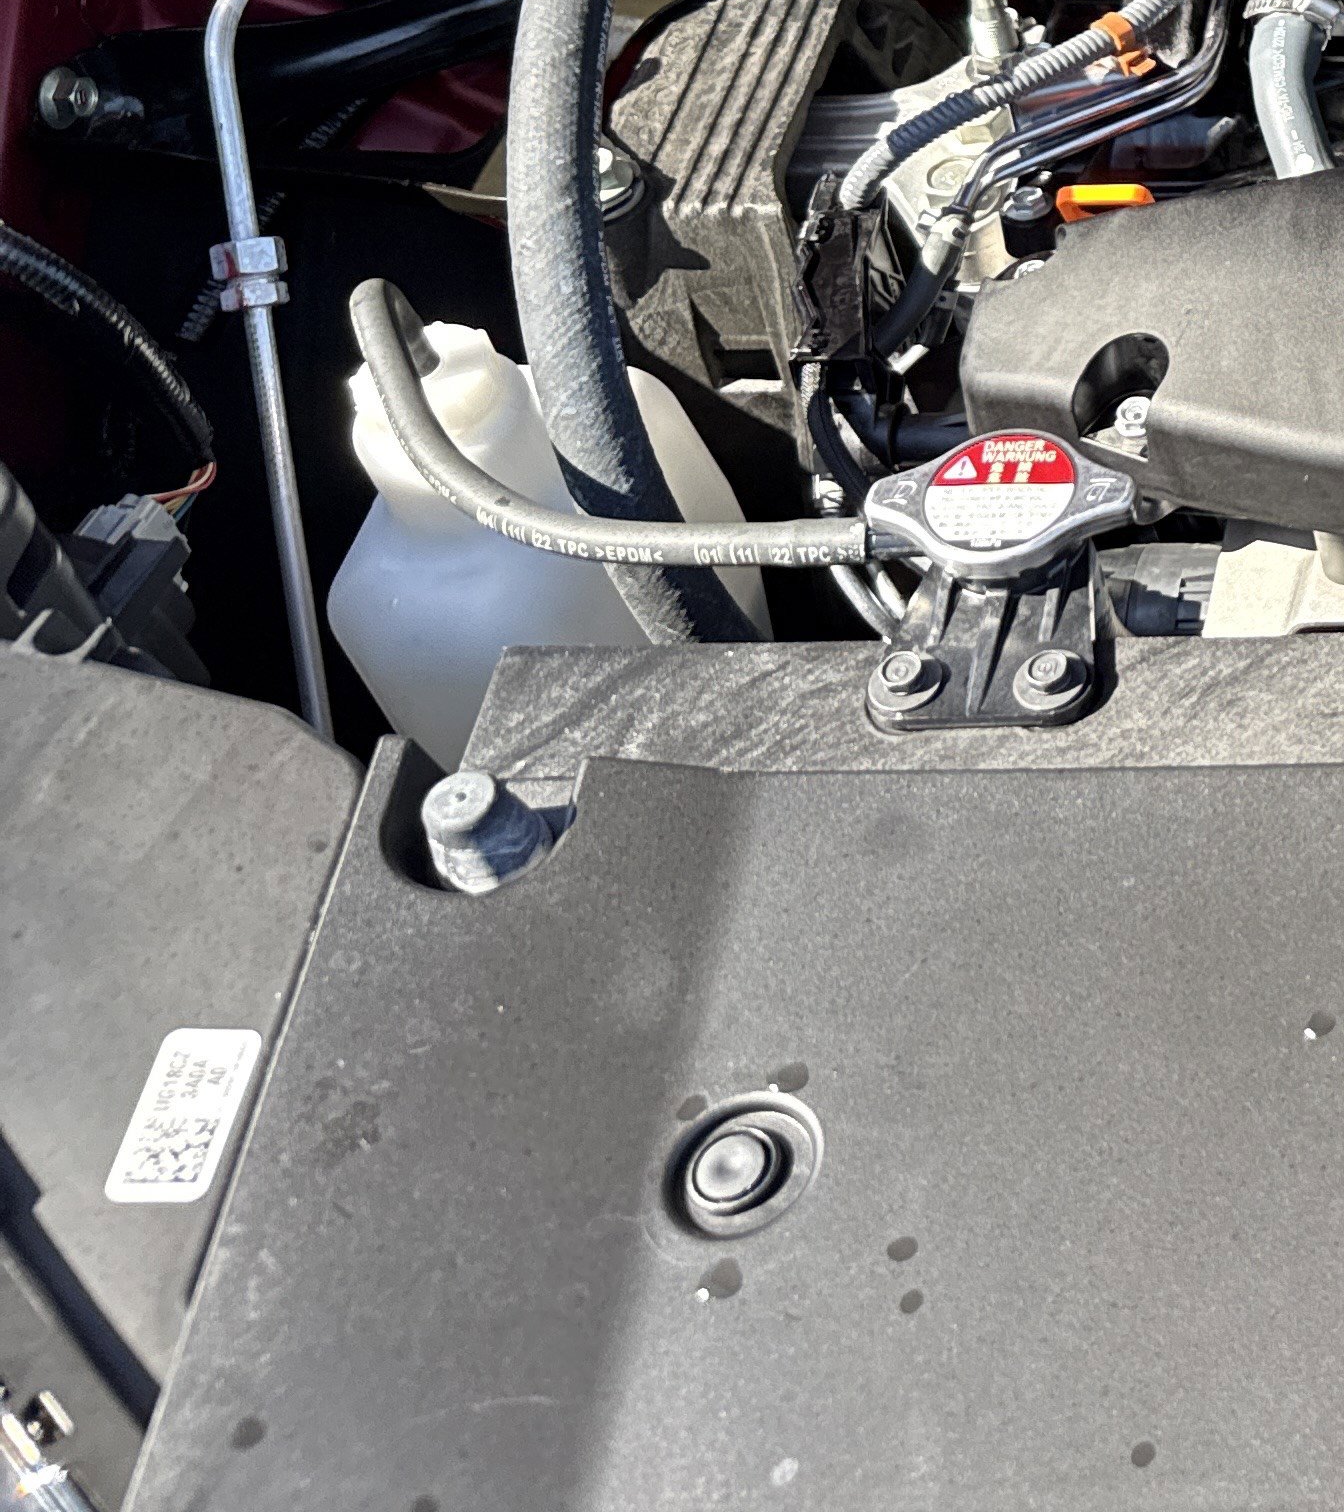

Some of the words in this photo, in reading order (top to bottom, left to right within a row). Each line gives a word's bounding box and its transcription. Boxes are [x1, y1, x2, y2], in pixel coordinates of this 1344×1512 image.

[984, 439, 1046, 452] DANGER
[982, 450, 1057, 463] WARNUNG
[557, 538, 589, 558] TPC
[595, 545, 664, 563] >EPDM<
[797, 546, 831, 563] TPC
